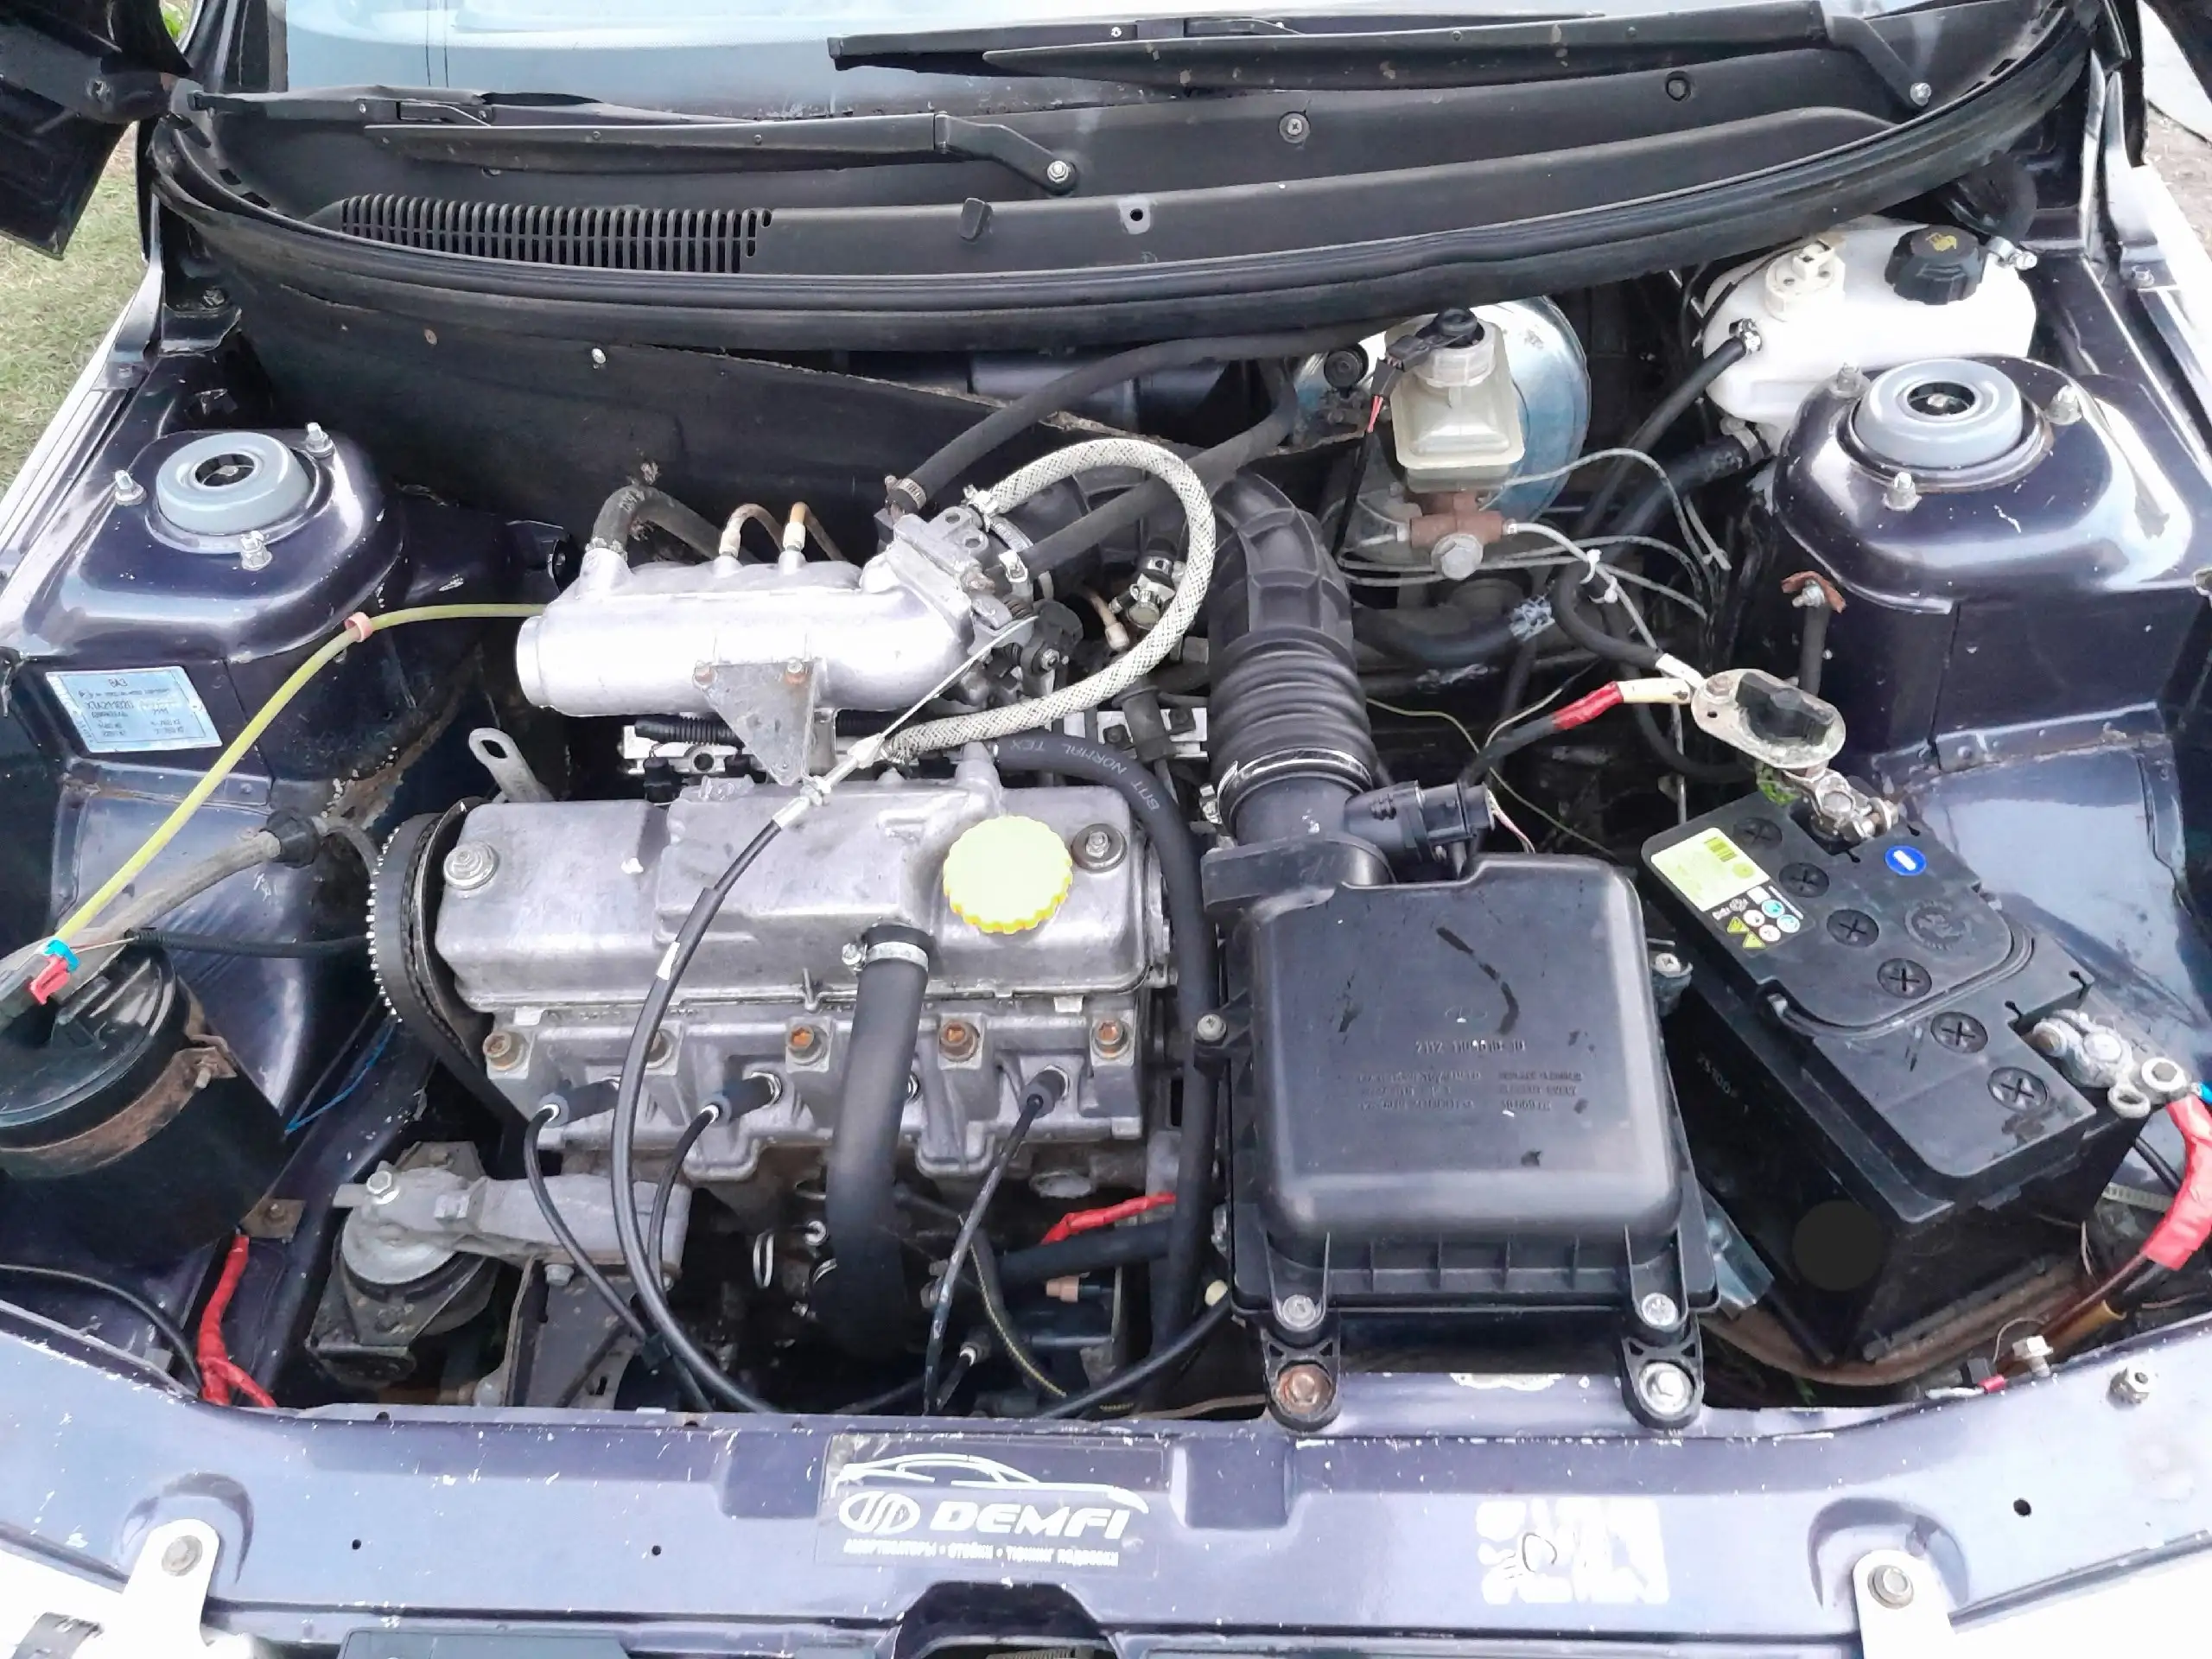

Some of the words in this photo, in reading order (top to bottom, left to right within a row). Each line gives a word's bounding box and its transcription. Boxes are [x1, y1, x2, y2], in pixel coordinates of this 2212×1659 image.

[1010, 739, 1046, 751] TEX
[1061, 742, 1128, 774] NORMAL
[929, 1501, 1130, 1539] DEMFI
